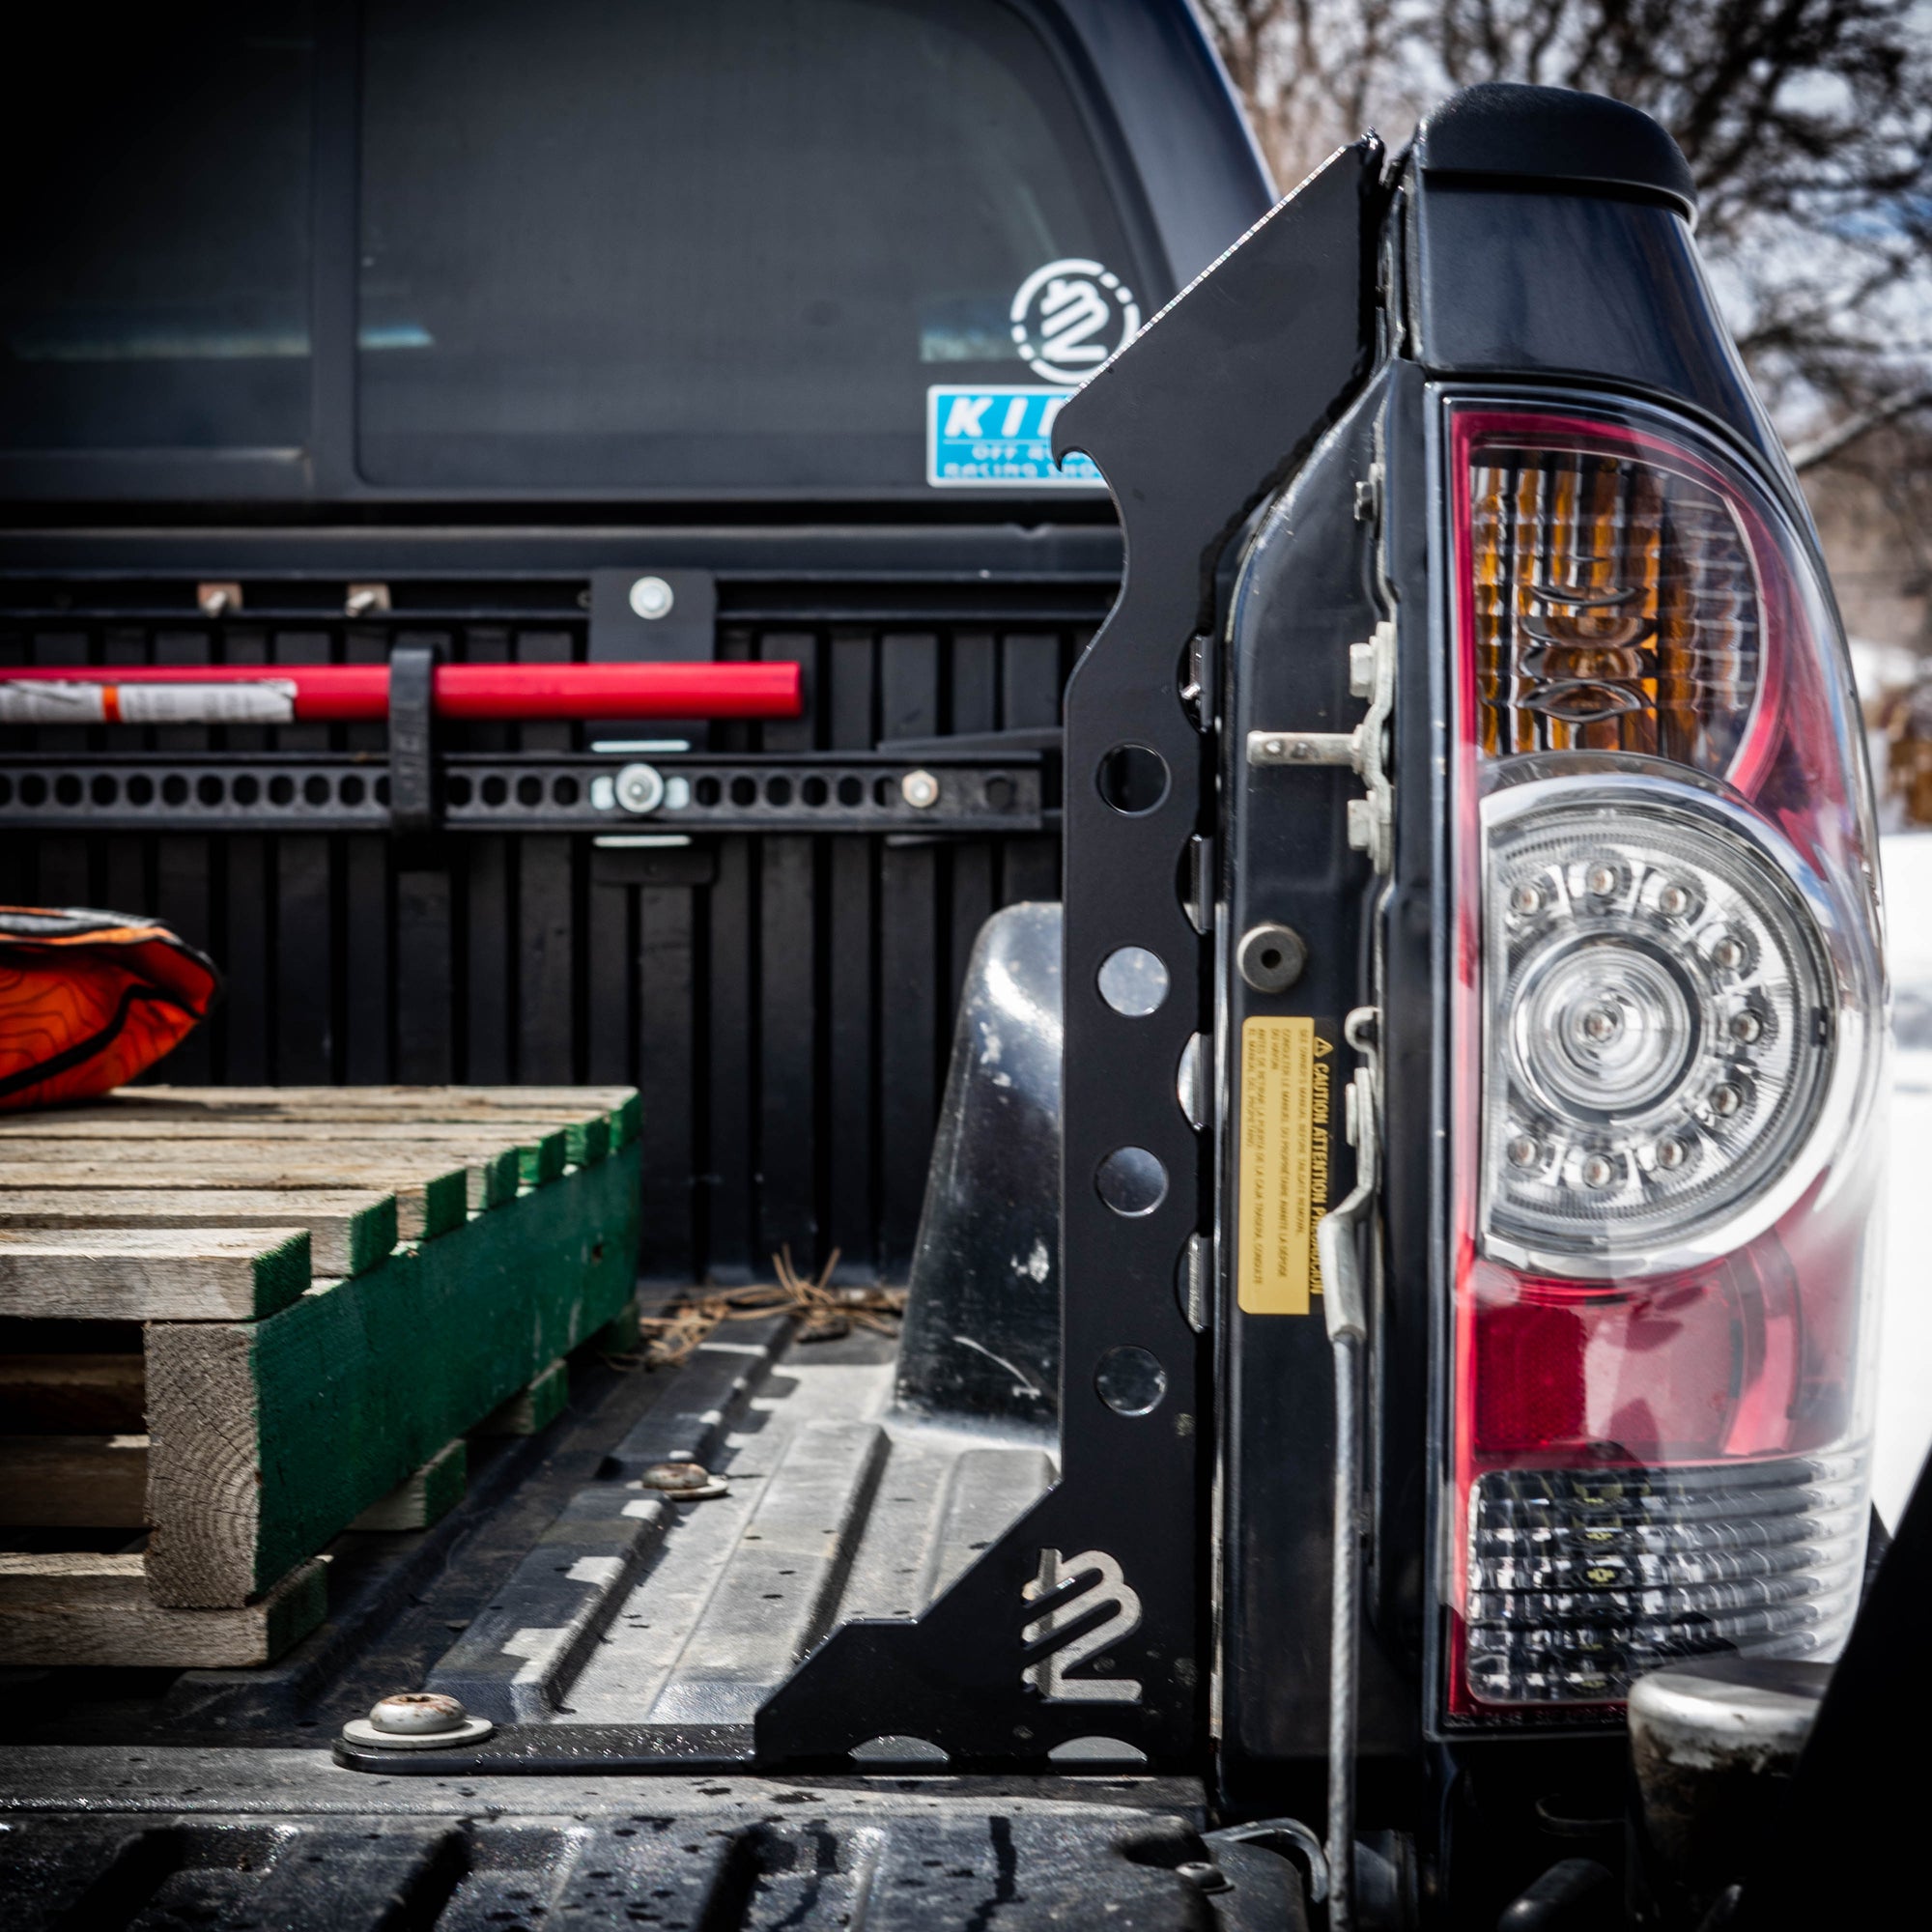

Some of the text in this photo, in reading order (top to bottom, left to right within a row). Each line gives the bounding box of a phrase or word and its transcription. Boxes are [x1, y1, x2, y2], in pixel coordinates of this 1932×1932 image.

[944, 397, 1067, 438] KI
[1313, 1063, 1329, 1123] CAUTION
[1311, 1127, 1328, 1203] ATTENTION
